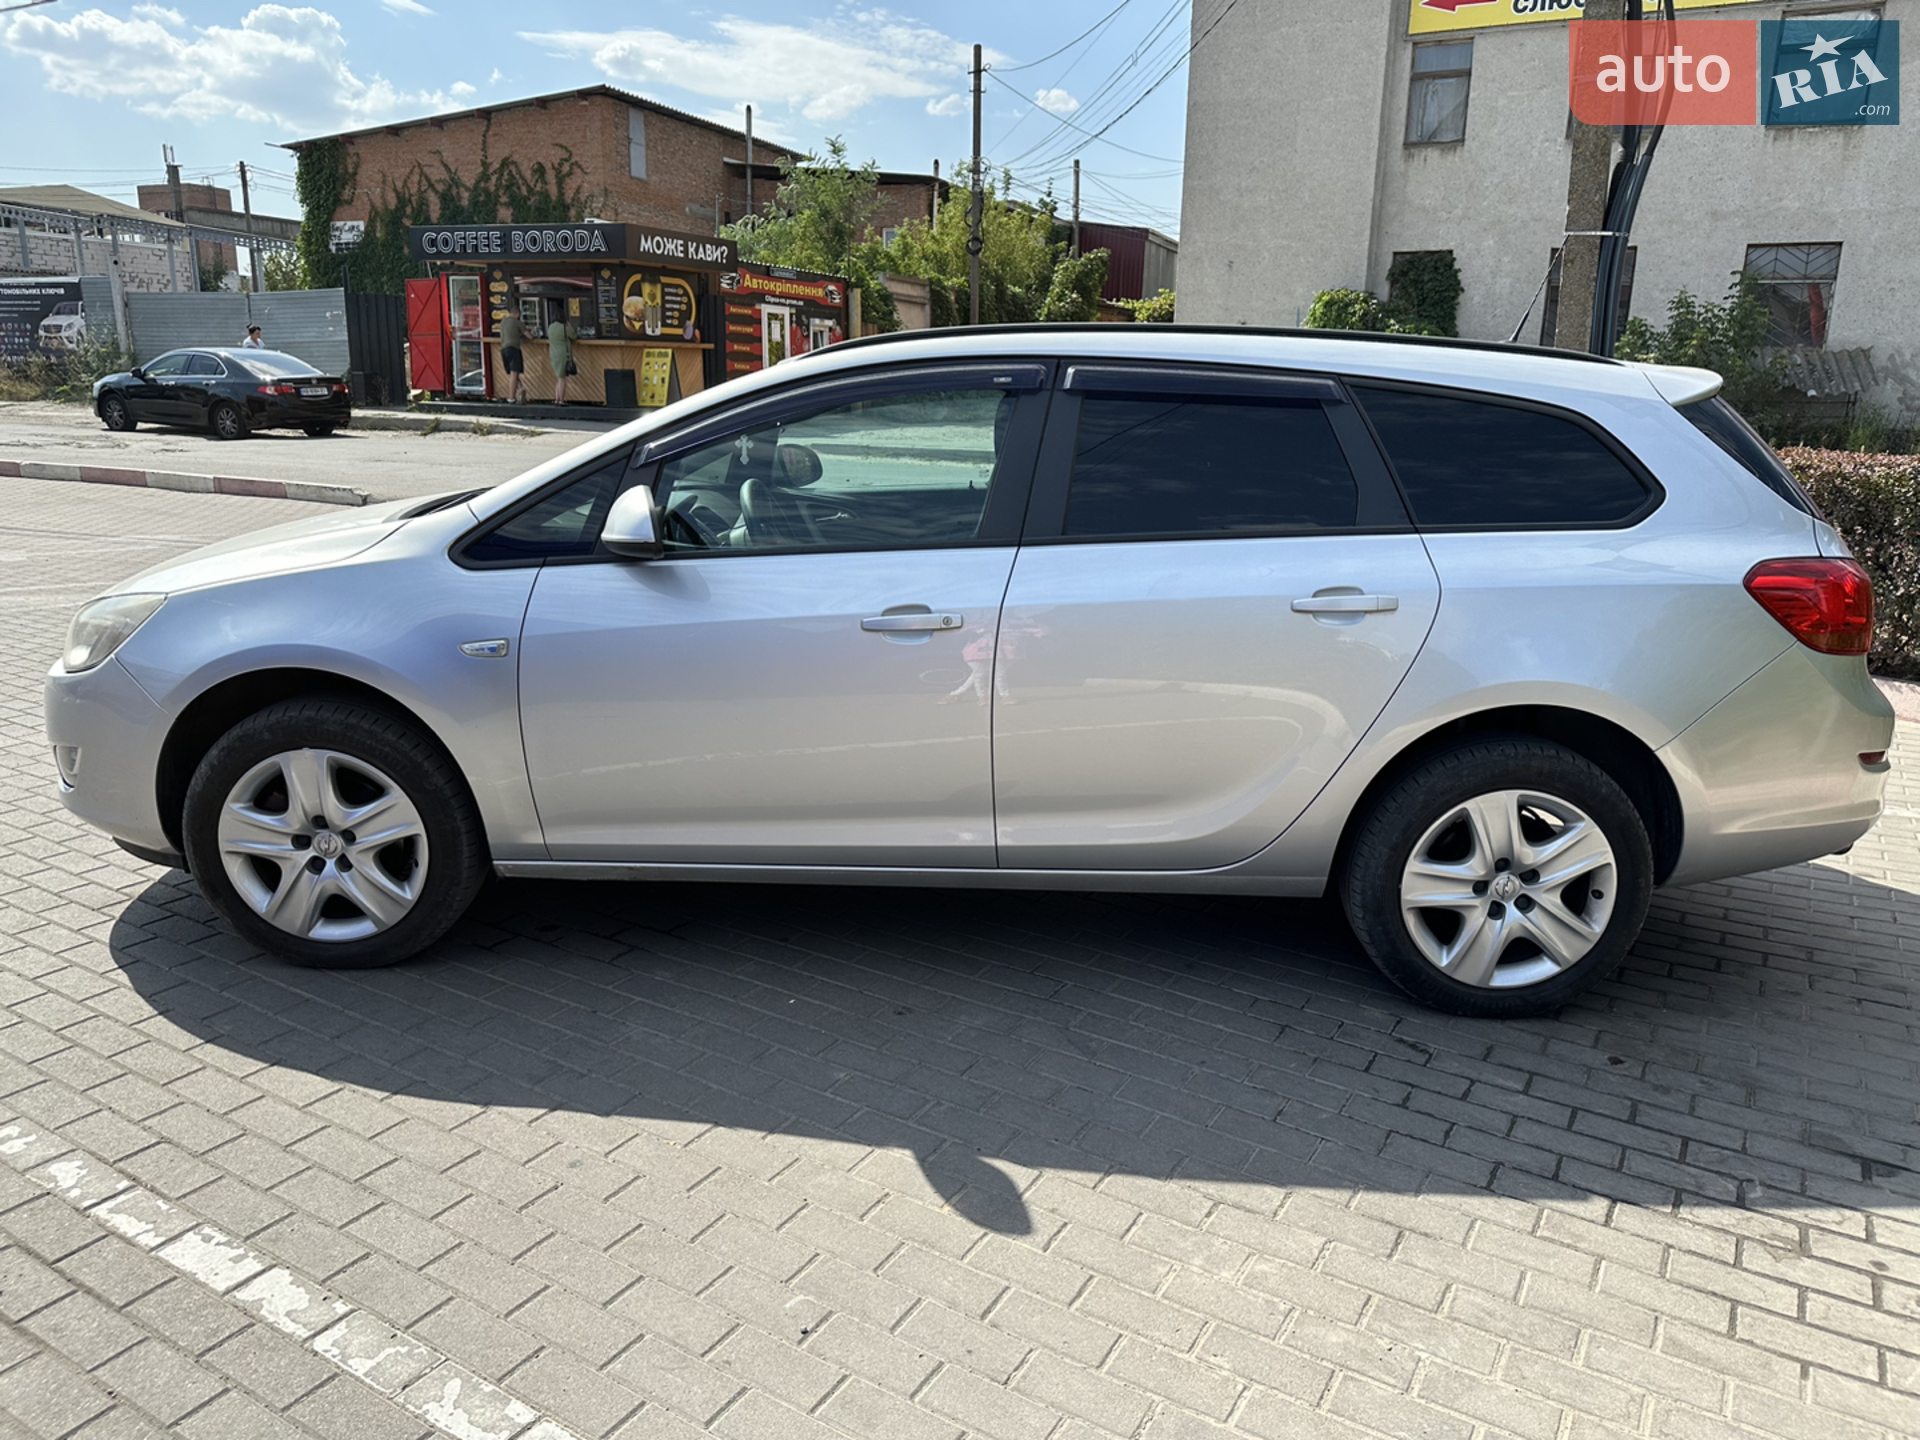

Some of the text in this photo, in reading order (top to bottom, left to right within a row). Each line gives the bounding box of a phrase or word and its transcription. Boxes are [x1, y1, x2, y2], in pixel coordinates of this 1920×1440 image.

[422, 229, 608, 254] COFFEE BORODA
[639, 234, 728, 264] МОЖЕ КАВИ?
[744, 274, 824, 297] Автокріплення
